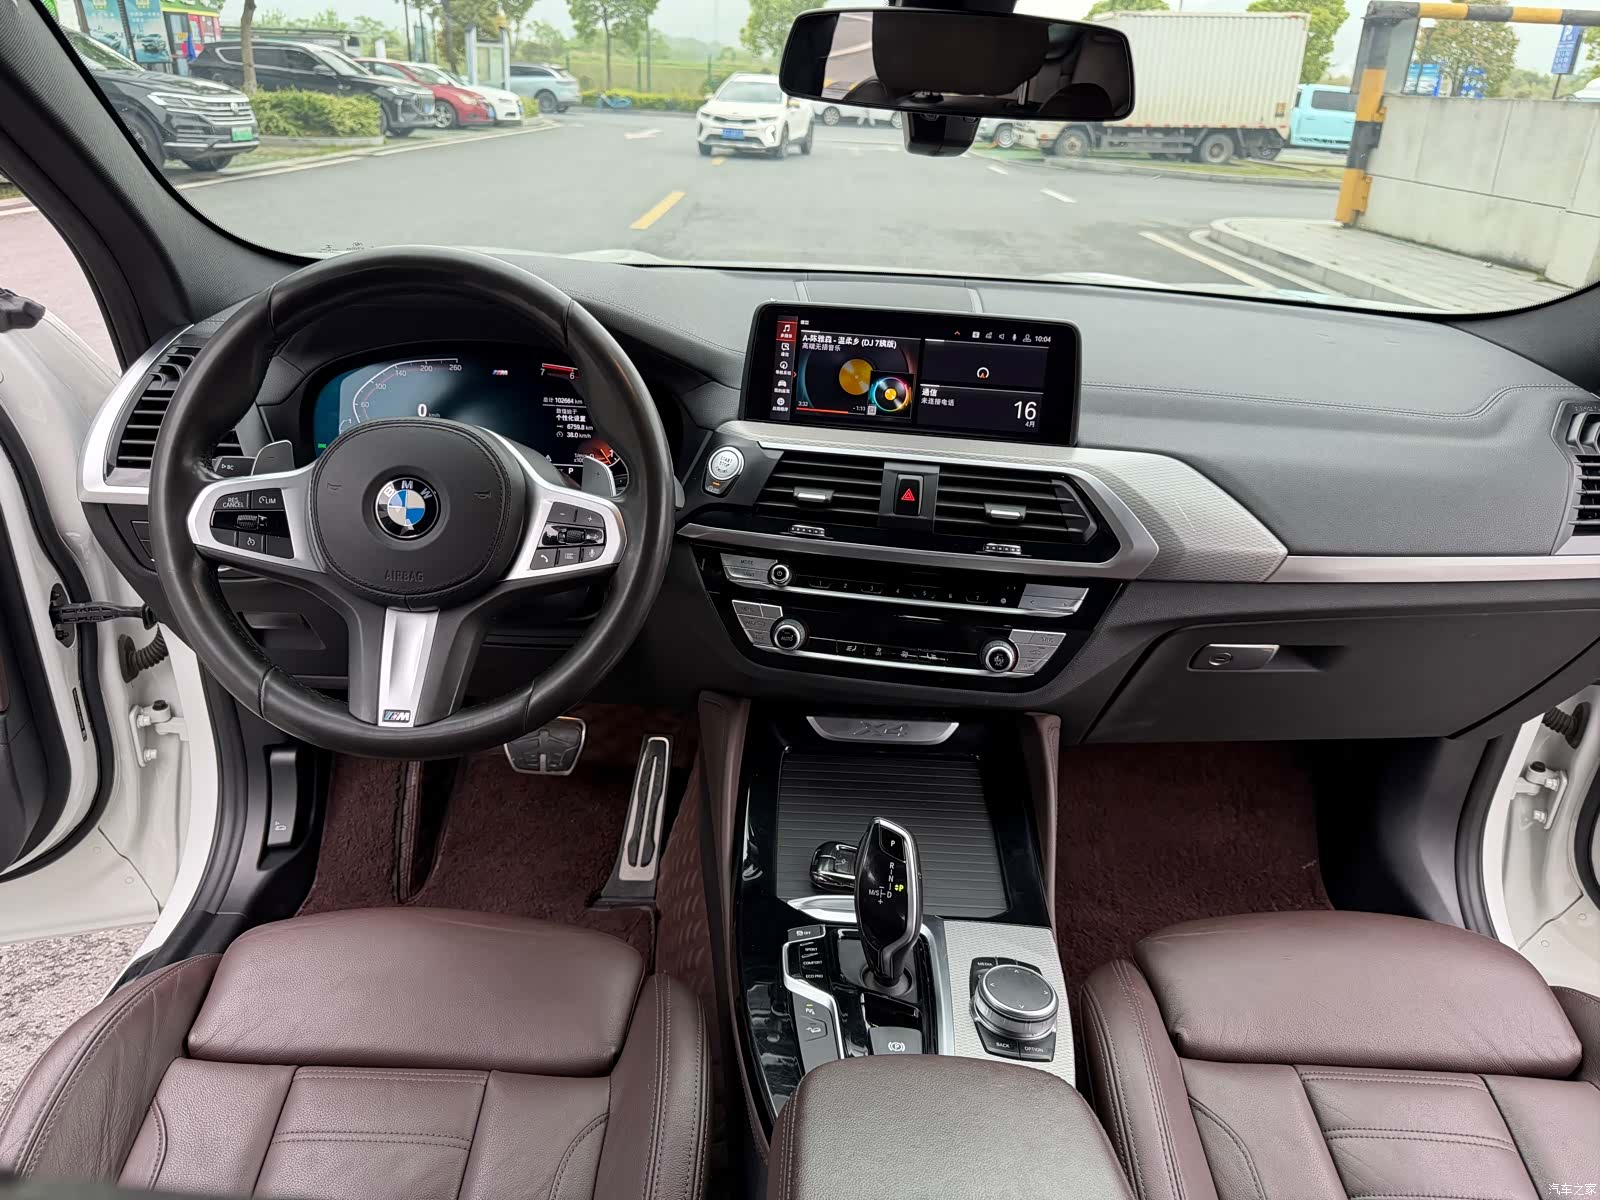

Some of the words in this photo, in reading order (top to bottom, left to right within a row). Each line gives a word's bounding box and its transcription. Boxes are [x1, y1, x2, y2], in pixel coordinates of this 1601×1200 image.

[449, 364, 462, 372] 260
[540, 368, 545, 376] 7
[569, 372, 575, 380] 6
[921, 388, 938, 397] 通信
[417, 404, 427, 417] 0
[1014, 401, 1037, 420] 16
[556, 414, 586, 422] 个性化设置
[1025, 420, 1036, 428] 4月
[384, 480, 433, 500] BMW
[384, 569, 424, 582] AIRBAG
[852, 721, 908, 737] X4
[899, 884, 904, 892] P
[886, 891, 893, 899] D
